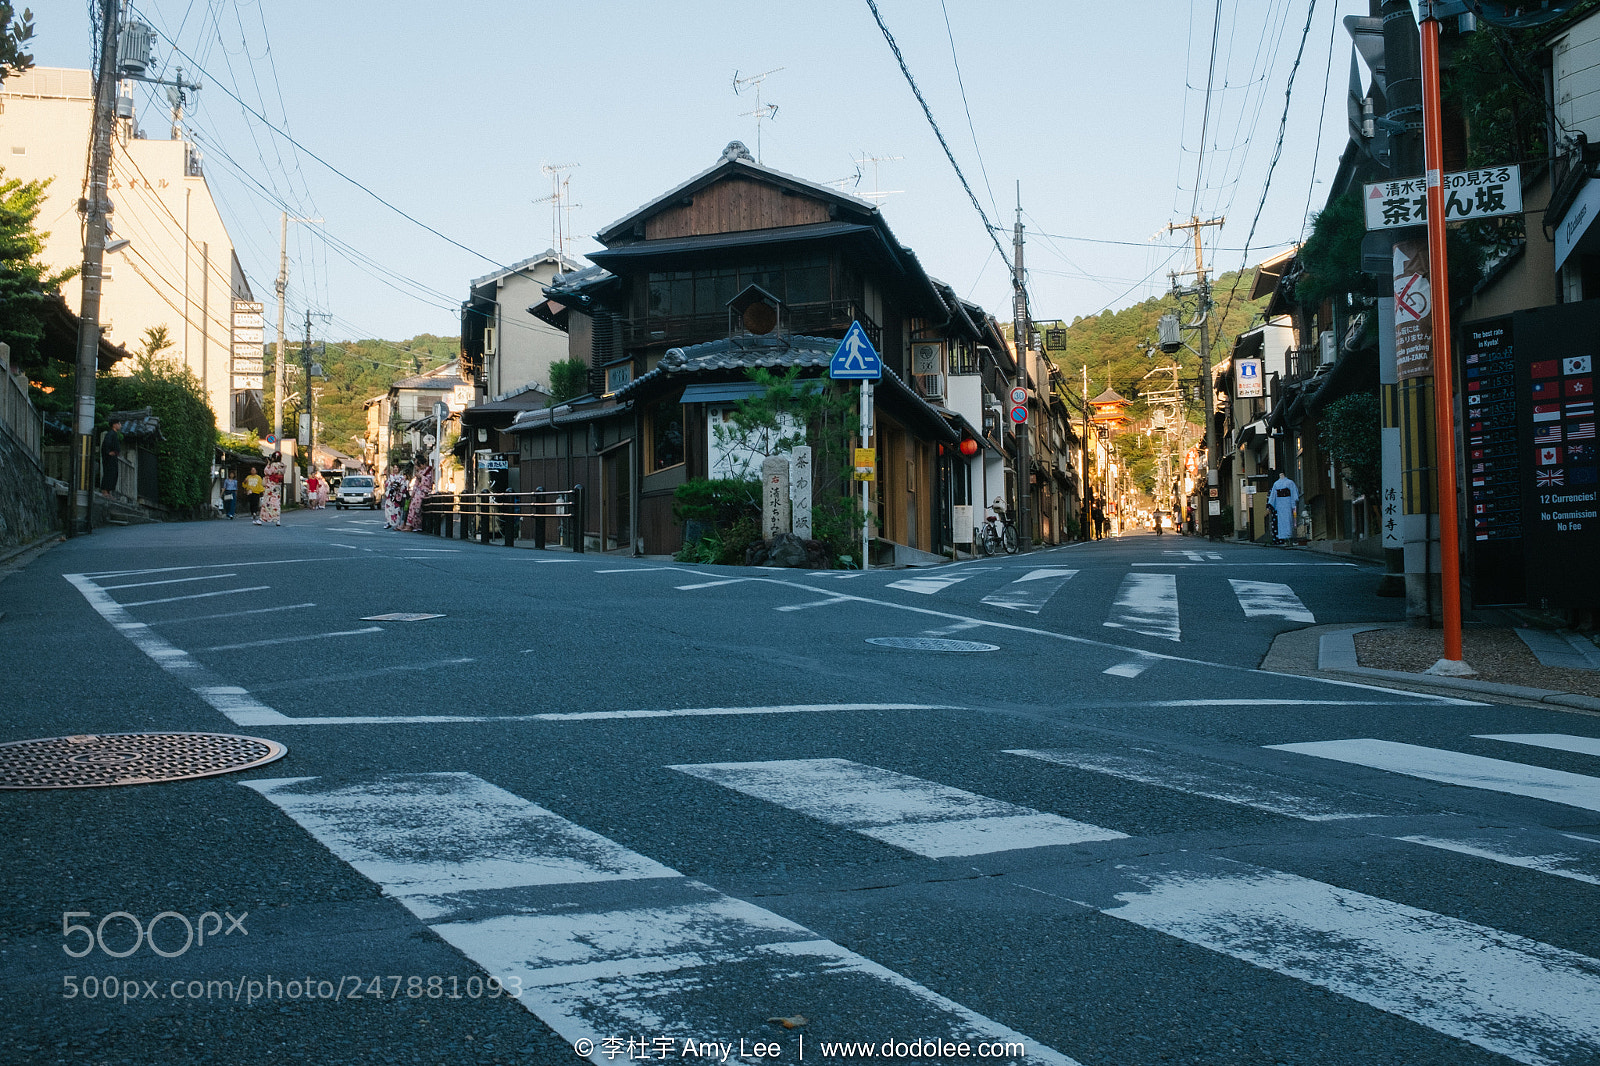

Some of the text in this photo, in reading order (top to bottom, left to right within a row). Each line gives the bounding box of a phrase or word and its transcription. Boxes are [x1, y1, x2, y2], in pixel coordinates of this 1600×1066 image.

[1473, 328, 1504, 340] The best rate
[1406, 343, 1430, 355] parking
[1478, 338, 1499, 349] in Kyoto!
[1014, 391, 1025, 400] 30
[795, 453, 810, 530] 茶わん坂
[1540, 491, 1598, 504] 12 Currencies!
[1384, 487, 1398, 541] 清水寺へ
[1541, 509, 1598, 521] No Commission
[1557, 521, 1583, 532] No Fee
